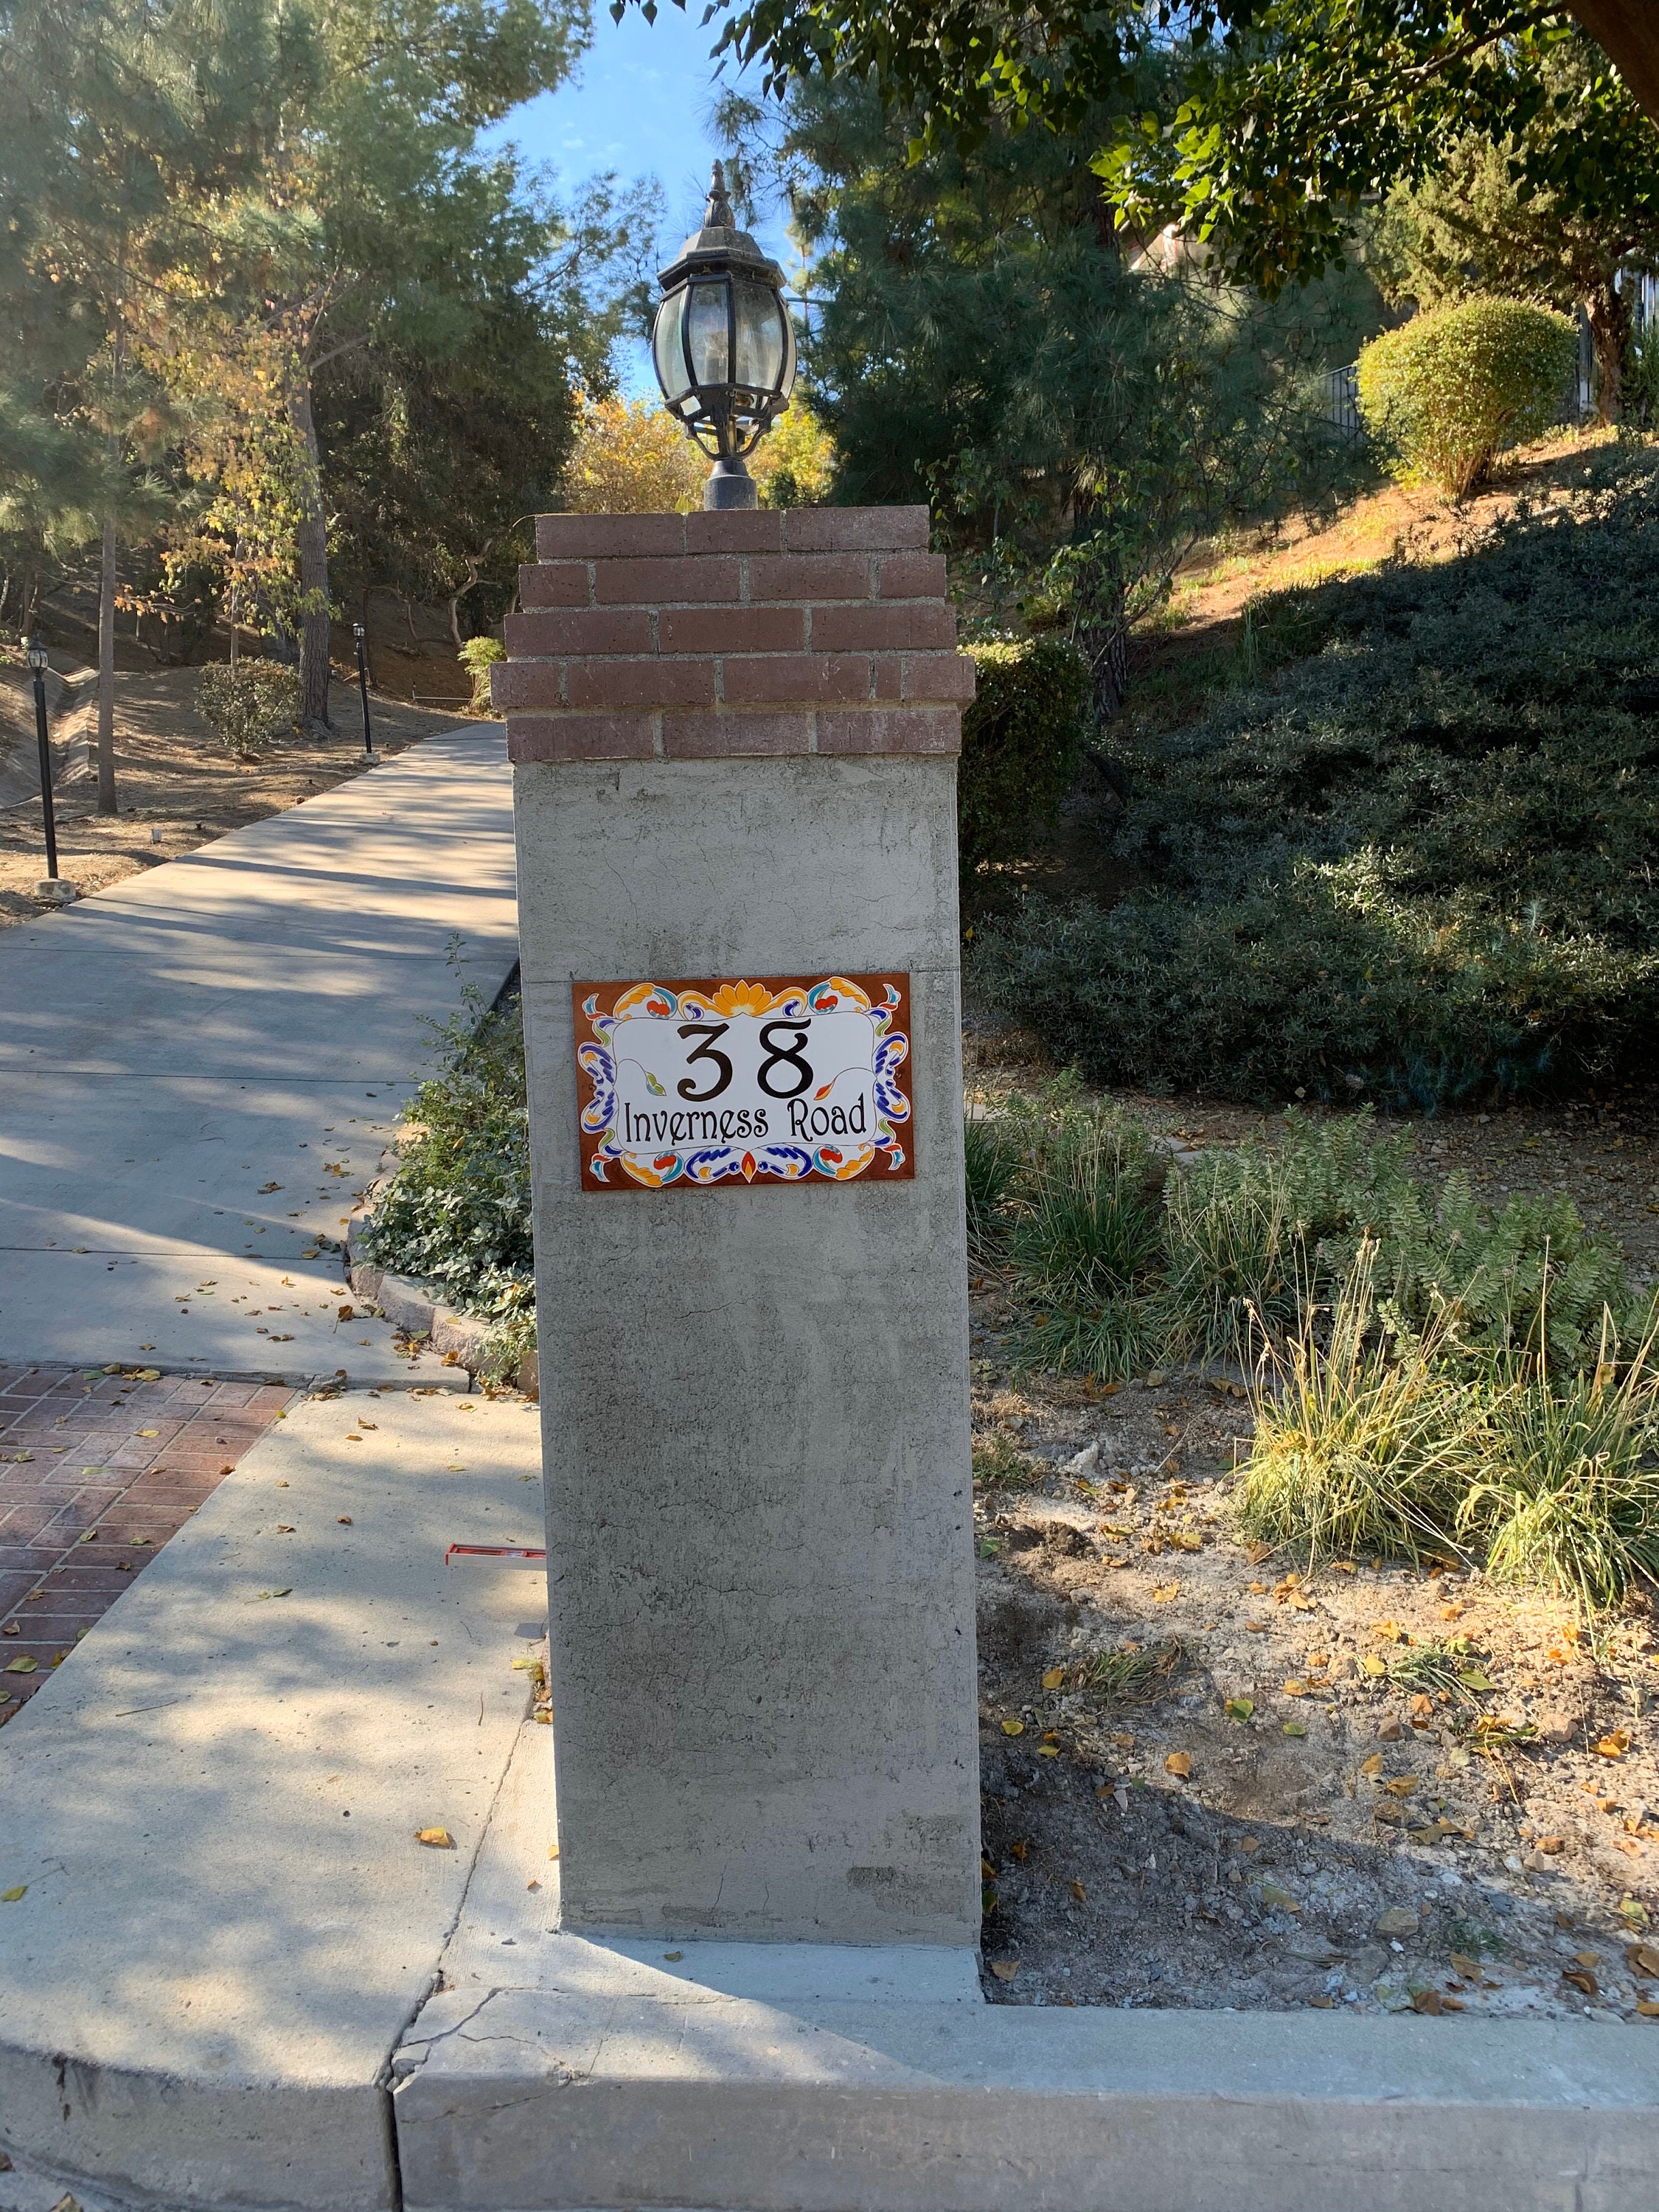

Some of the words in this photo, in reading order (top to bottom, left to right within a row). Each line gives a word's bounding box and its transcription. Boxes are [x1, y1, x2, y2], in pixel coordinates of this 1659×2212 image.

[676, 1018, 814, 1102] 38
[624, 1102, 769, 1144] Inverness
[787, 1092, 867, 1142] Road
